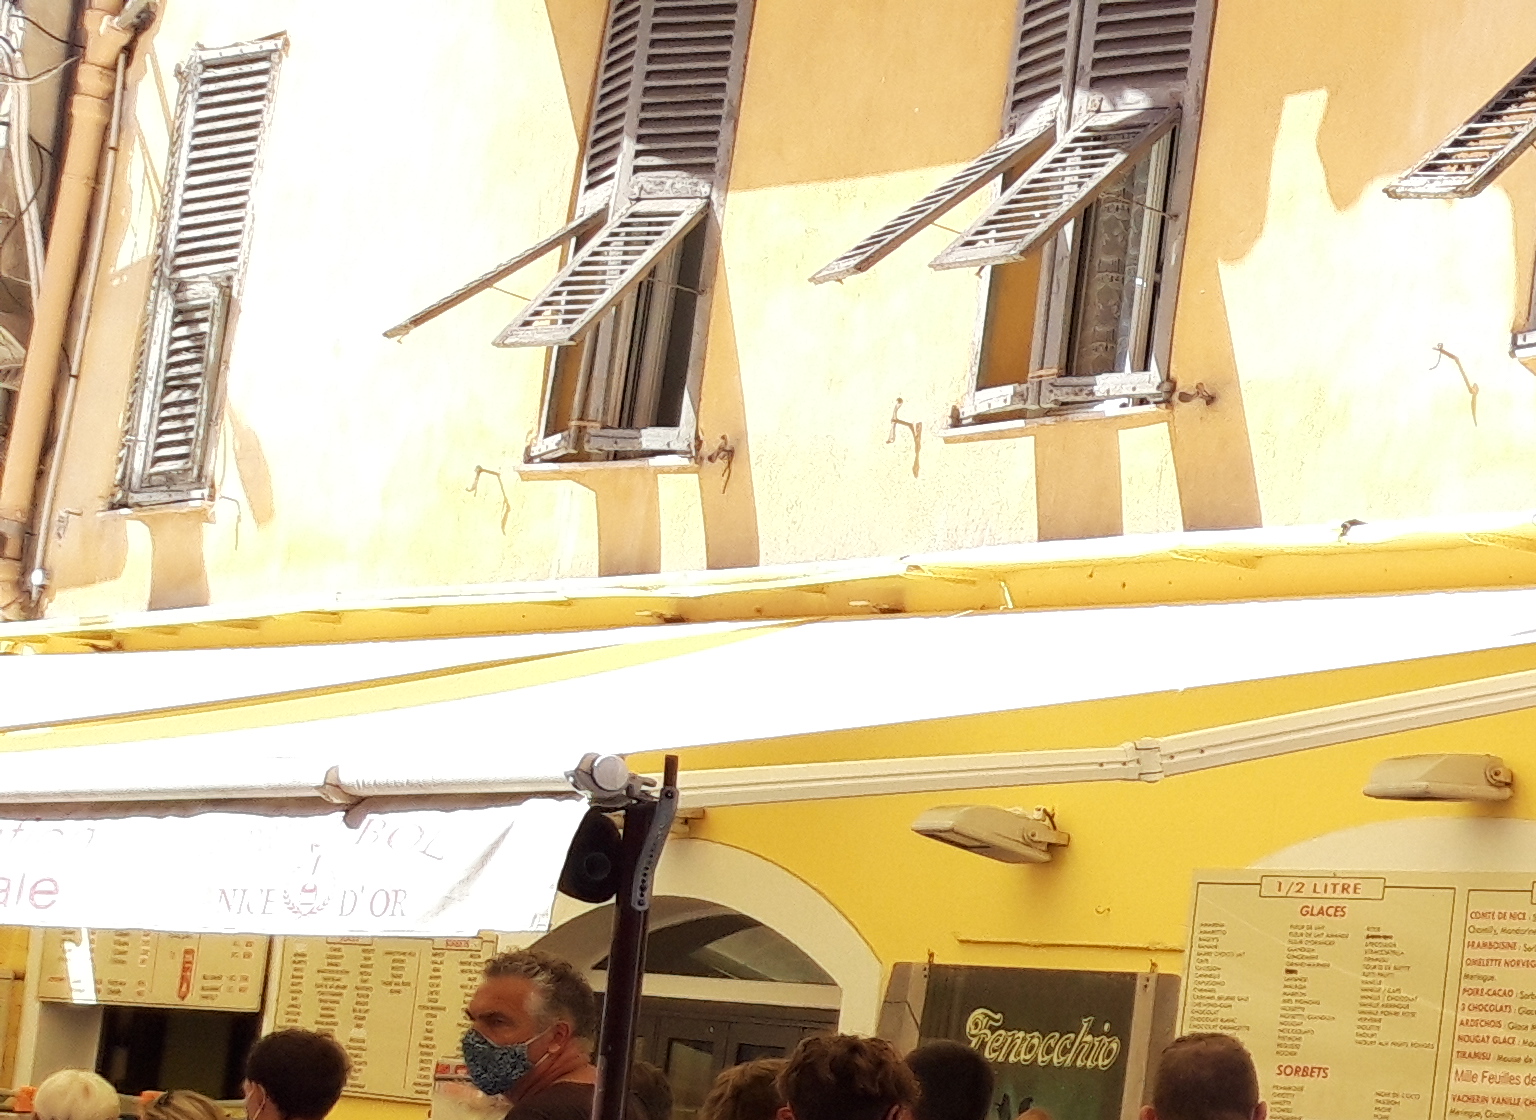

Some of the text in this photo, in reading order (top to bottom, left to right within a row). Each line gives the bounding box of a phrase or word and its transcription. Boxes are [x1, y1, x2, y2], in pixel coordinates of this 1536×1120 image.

[1275, 881, 1362, 896] 1/2 LITRE
[338, 885, 408, 918] D'OR
[1299, 905, 1347, 917] GLACES
[965, 1007, 1121, 1071] Fenocchio
[1276, 1065, 1329, 1078] SORBETS
[1454, 1069, 1479, 1083] Mille
[1481, 1070, 1521, 1085] Feuilles
